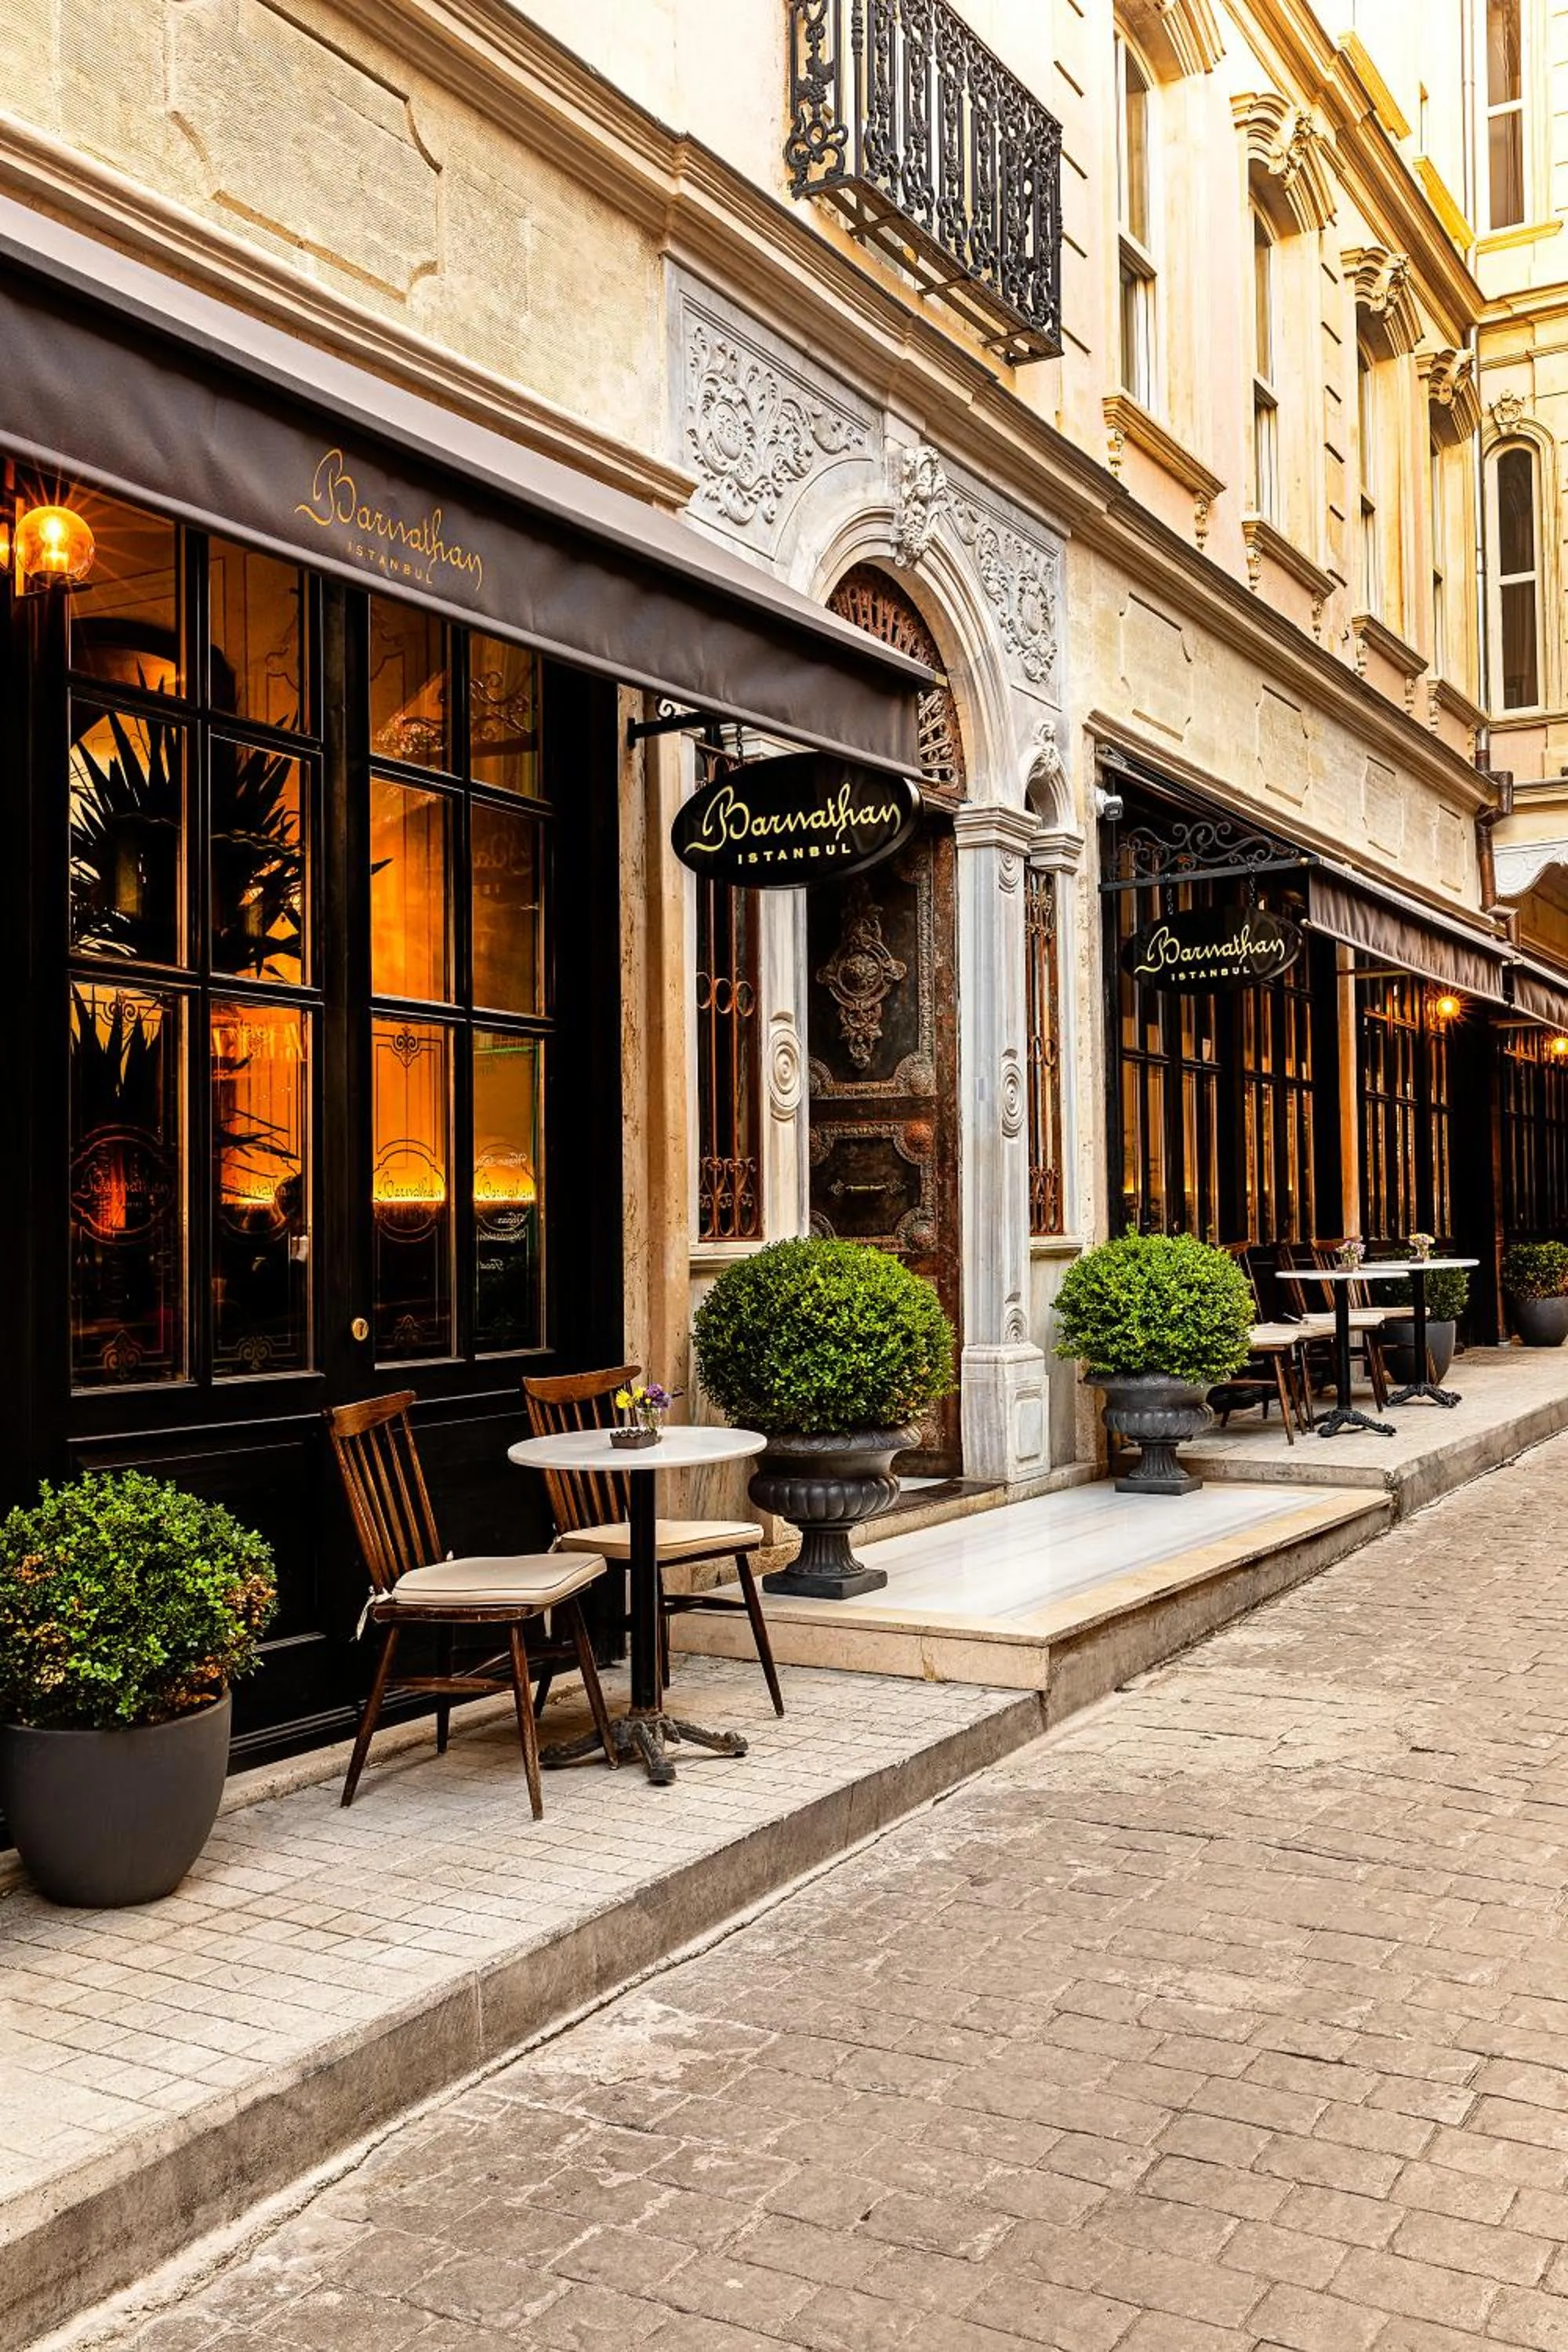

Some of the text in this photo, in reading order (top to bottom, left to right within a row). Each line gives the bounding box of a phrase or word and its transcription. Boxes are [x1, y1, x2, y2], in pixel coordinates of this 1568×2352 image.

[295, 448, 482, 591] Barnathan
[347, 540, 434, 584] ISTANBUL
[684, 783, 901, 854] Barnathan
[738, 843, 851, 864] ISTANBUL
[1134, 924, 1285, 974] Barnathan
[1171, 966, 1250, 982] ISTANBUL
